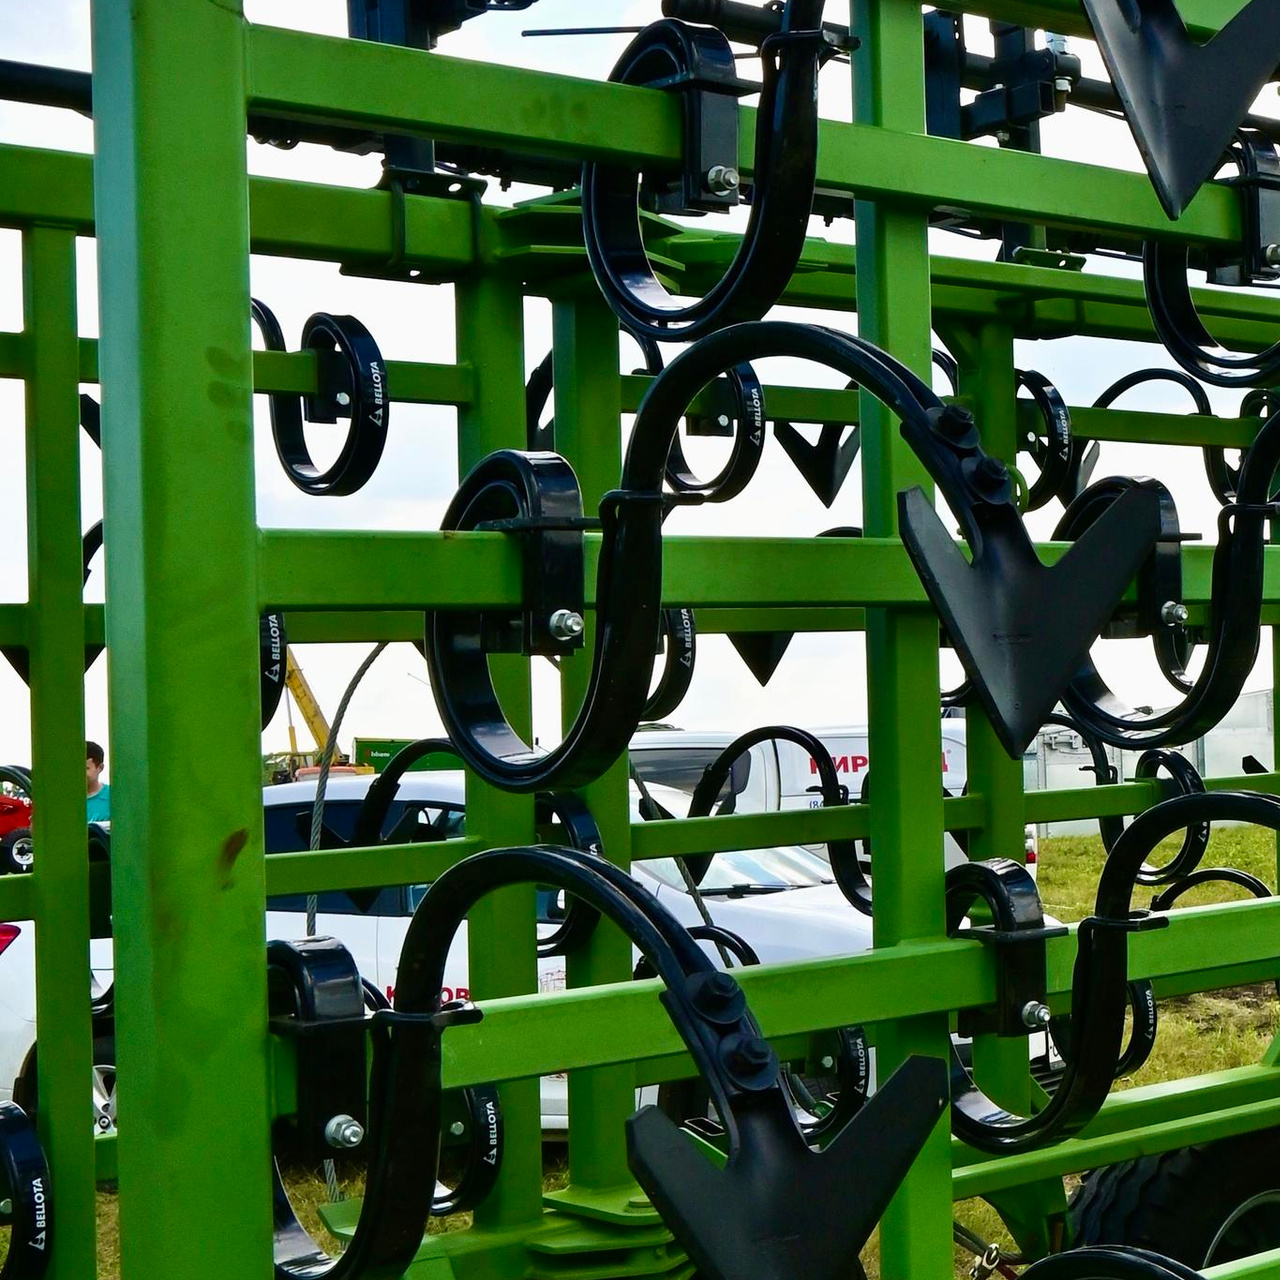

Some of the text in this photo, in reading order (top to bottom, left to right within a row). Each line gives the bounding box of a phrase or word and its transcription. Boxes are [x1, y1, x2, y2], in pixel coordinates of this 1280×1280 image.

[369, 361, 383, 405] BELLOTA
[751, 388, 761, 427] BELLOTA
[1059, 409, 1069, 445] BELLOTA
[267, 614, 281, 661] BELLOTA
[1145, 989, 1154, 1024] BELLOTA
[855, 1037, 866, 1076] BELLOTA
[485, 1101, 498, 1145] BELLOTA
[31, 1177, 46, 1228] BELLOTA
